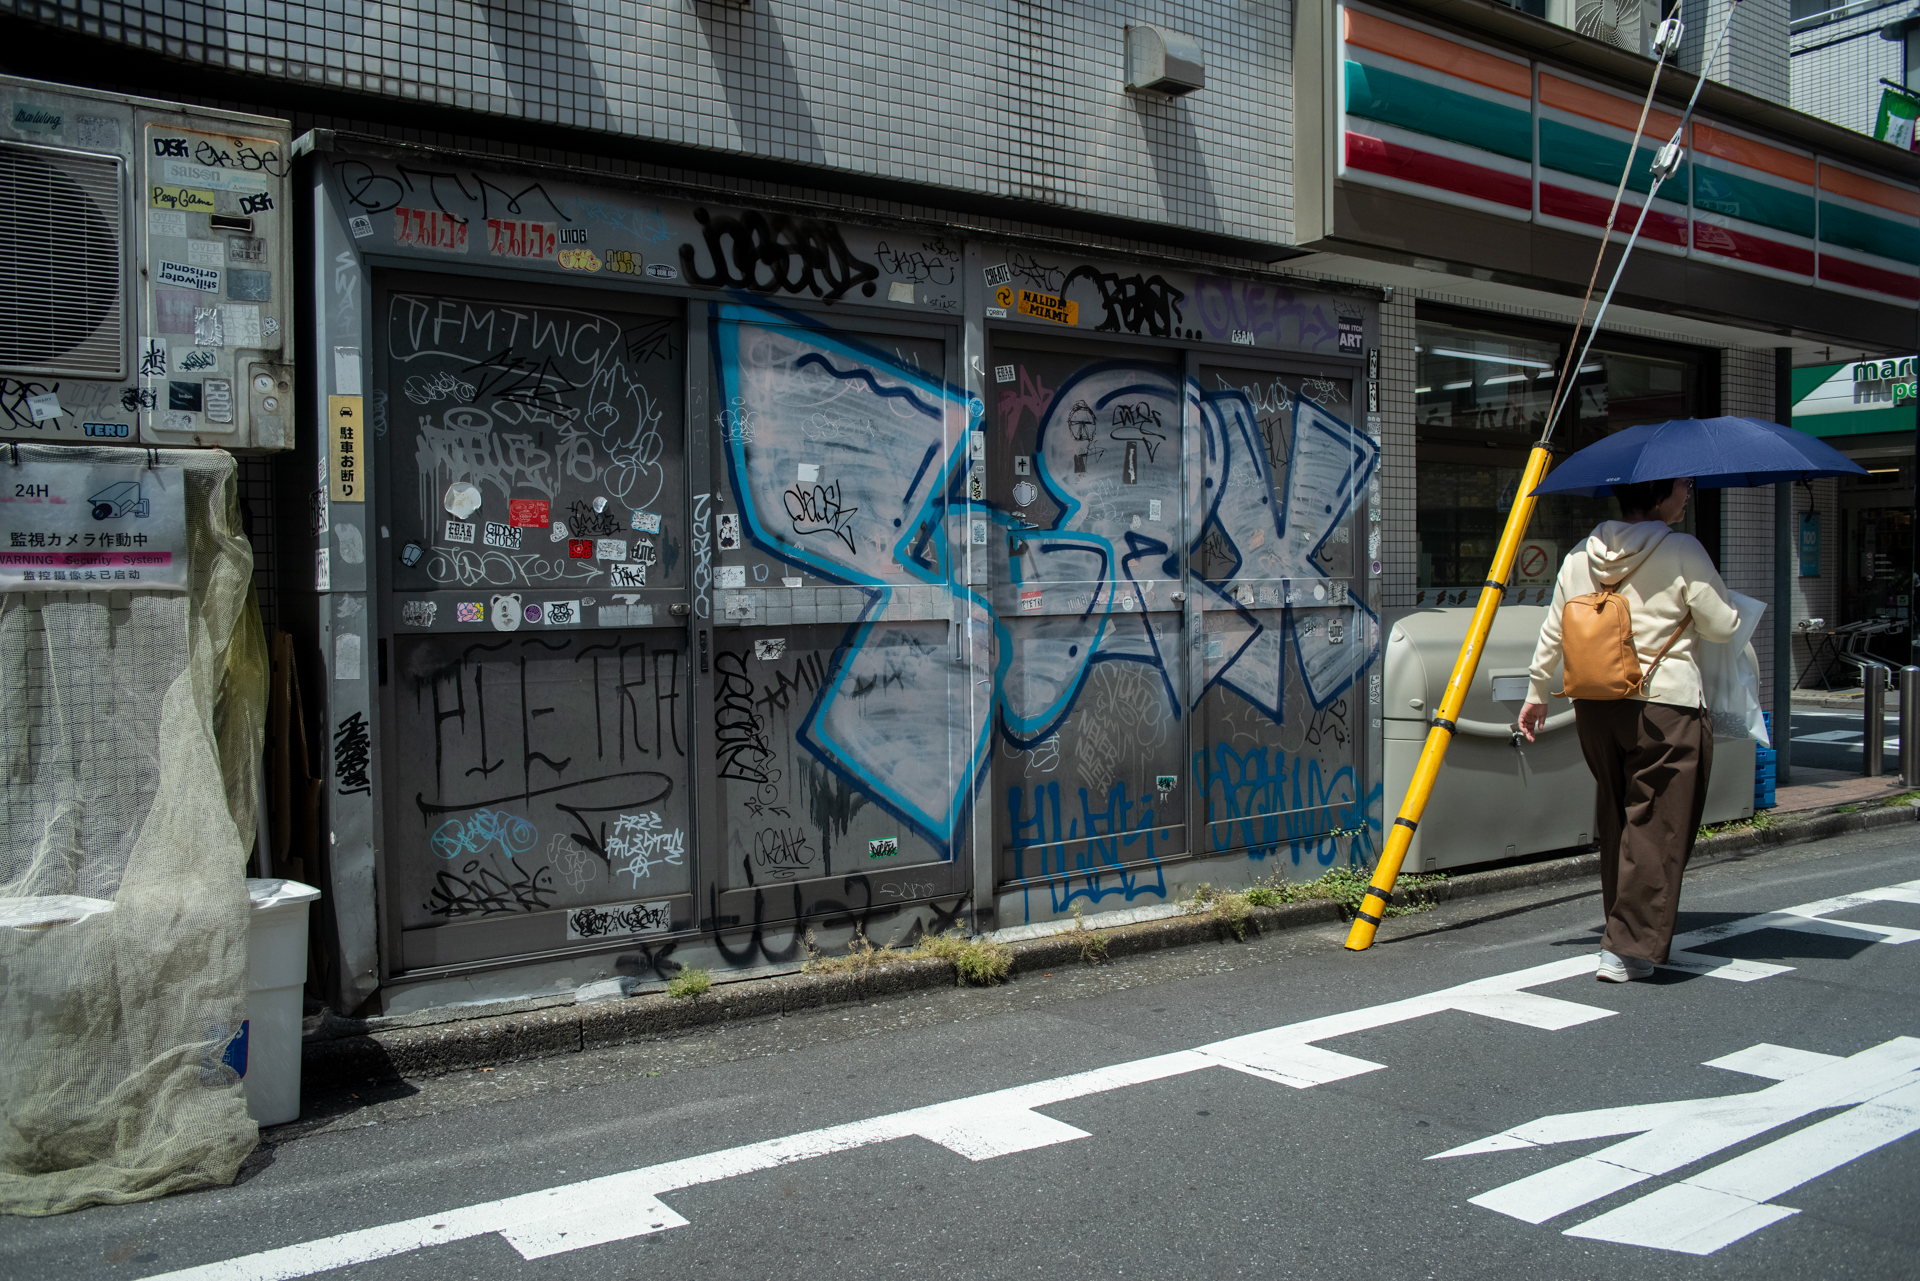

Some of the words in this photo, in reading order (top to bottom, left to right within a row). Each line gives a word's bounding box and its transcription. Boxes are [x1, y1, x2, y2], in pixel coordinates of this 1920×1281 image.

[159, 272, 217, 290] stillwater
[984, 265, 1010, 286] CREATE
[1029, 304, 1069, 323] MIAMI
[1339, 322, 1350, 331] IVAN
[1351, 324, 1363, 332] ITCH
[1338, 333, 1362, 348] ART
[83, 422, 129, 438] TERU
[340, 427, 354, 496] 駐車お断り
[15, 484, 49, 498] 24H
[10, 532, 148, 547] 監視カメラ作動中
[568, 539, 592, 549] BLUE
[0, 555, 53, 565] WARNING
[65, 555, 112, 566] Security
[123, 555, 163, 566] System
[569, 548, 592, 559] BIRD
